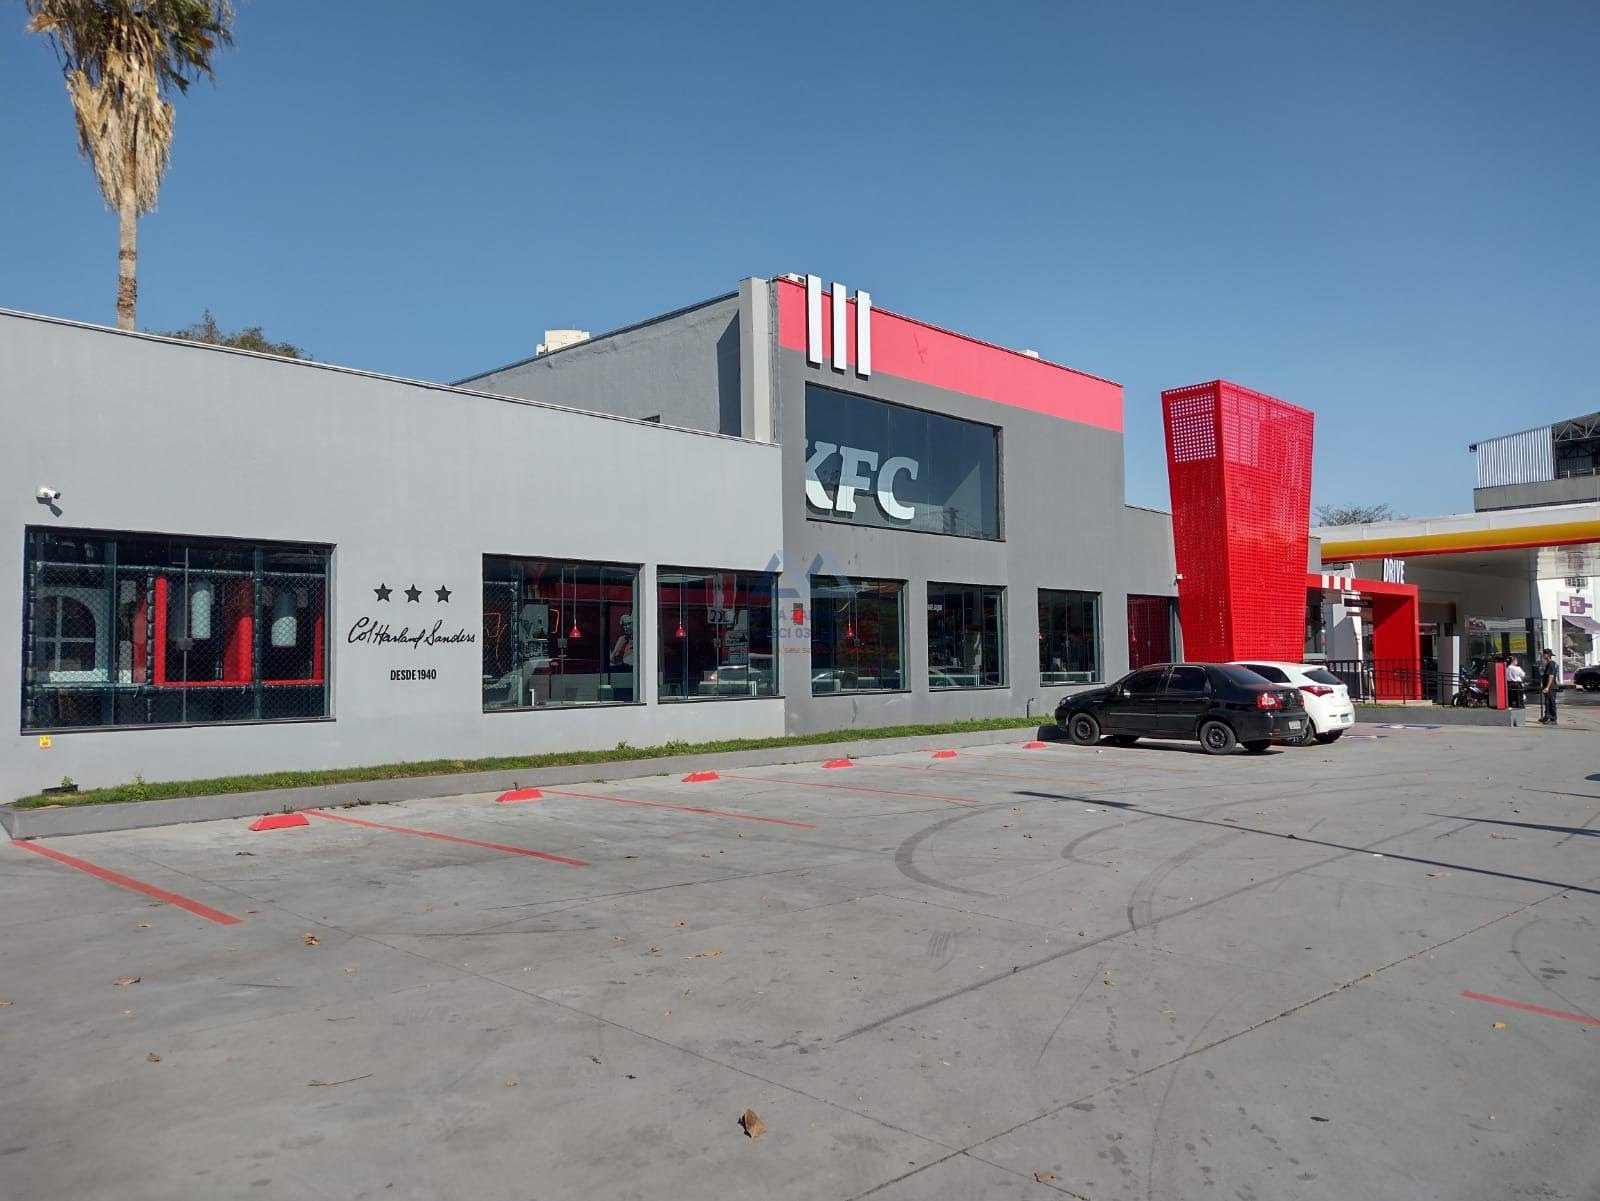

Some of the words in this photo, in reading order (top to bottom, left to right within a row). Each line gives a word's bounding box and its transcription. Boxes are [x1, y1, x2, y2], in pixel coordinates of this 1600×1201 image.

[805, 439, 919, 520] KFC
[1383, 558, 1405, 584] DRIVE
[425, 619, 476, 646] Sanders
[390, 669, 416, 681] DESDE
[418, 669, 436, 680] 1940
